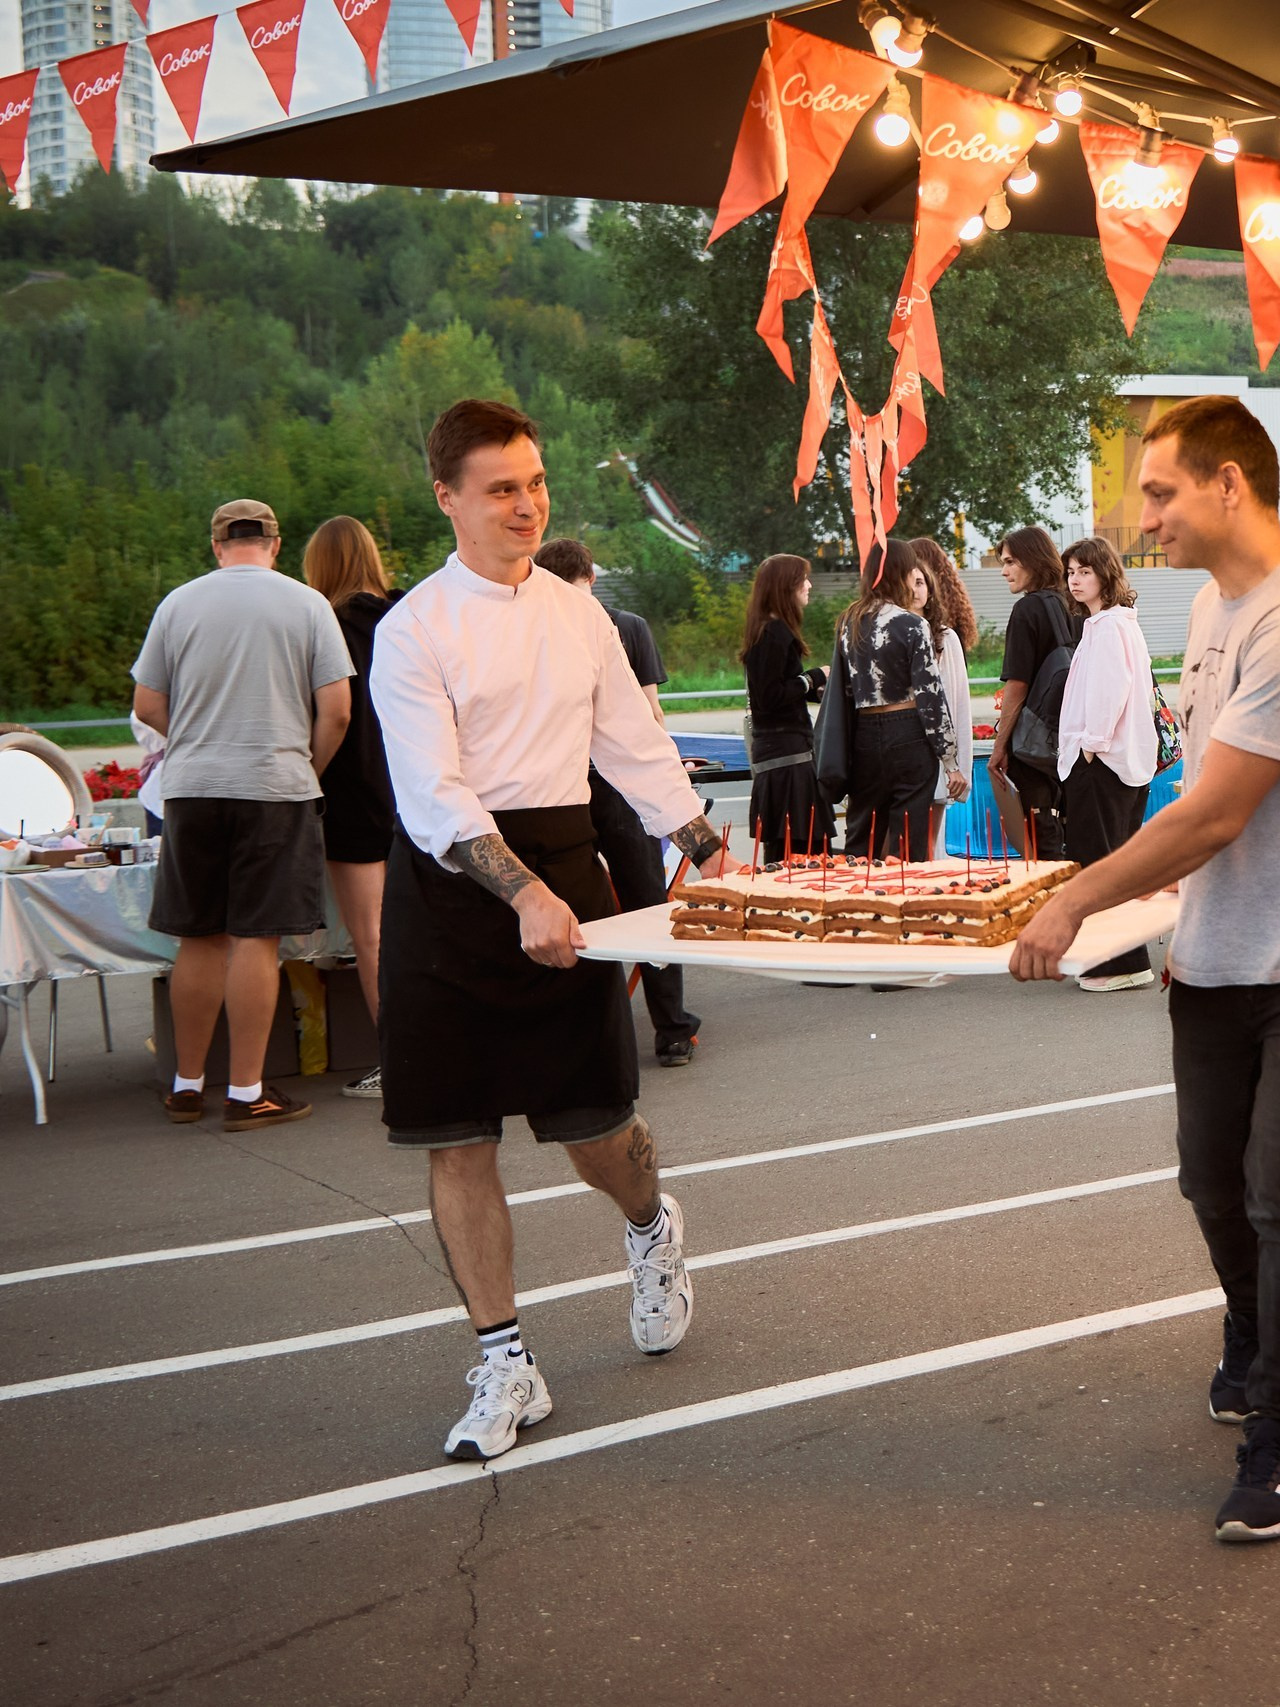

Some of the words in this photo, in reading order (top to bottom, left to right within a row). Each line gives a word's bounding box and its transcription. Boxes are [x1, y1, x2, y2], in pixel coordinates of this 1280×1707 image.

[251, 14, 301, 49] Совок
[160, 42, 211, 77] Совок
[73, 72, 120, 105] Совок
[781, 73, 870, 112] Совок
[925, 123, 1020, 164] Совок
[1098, 174, 1184, 210] Совок
